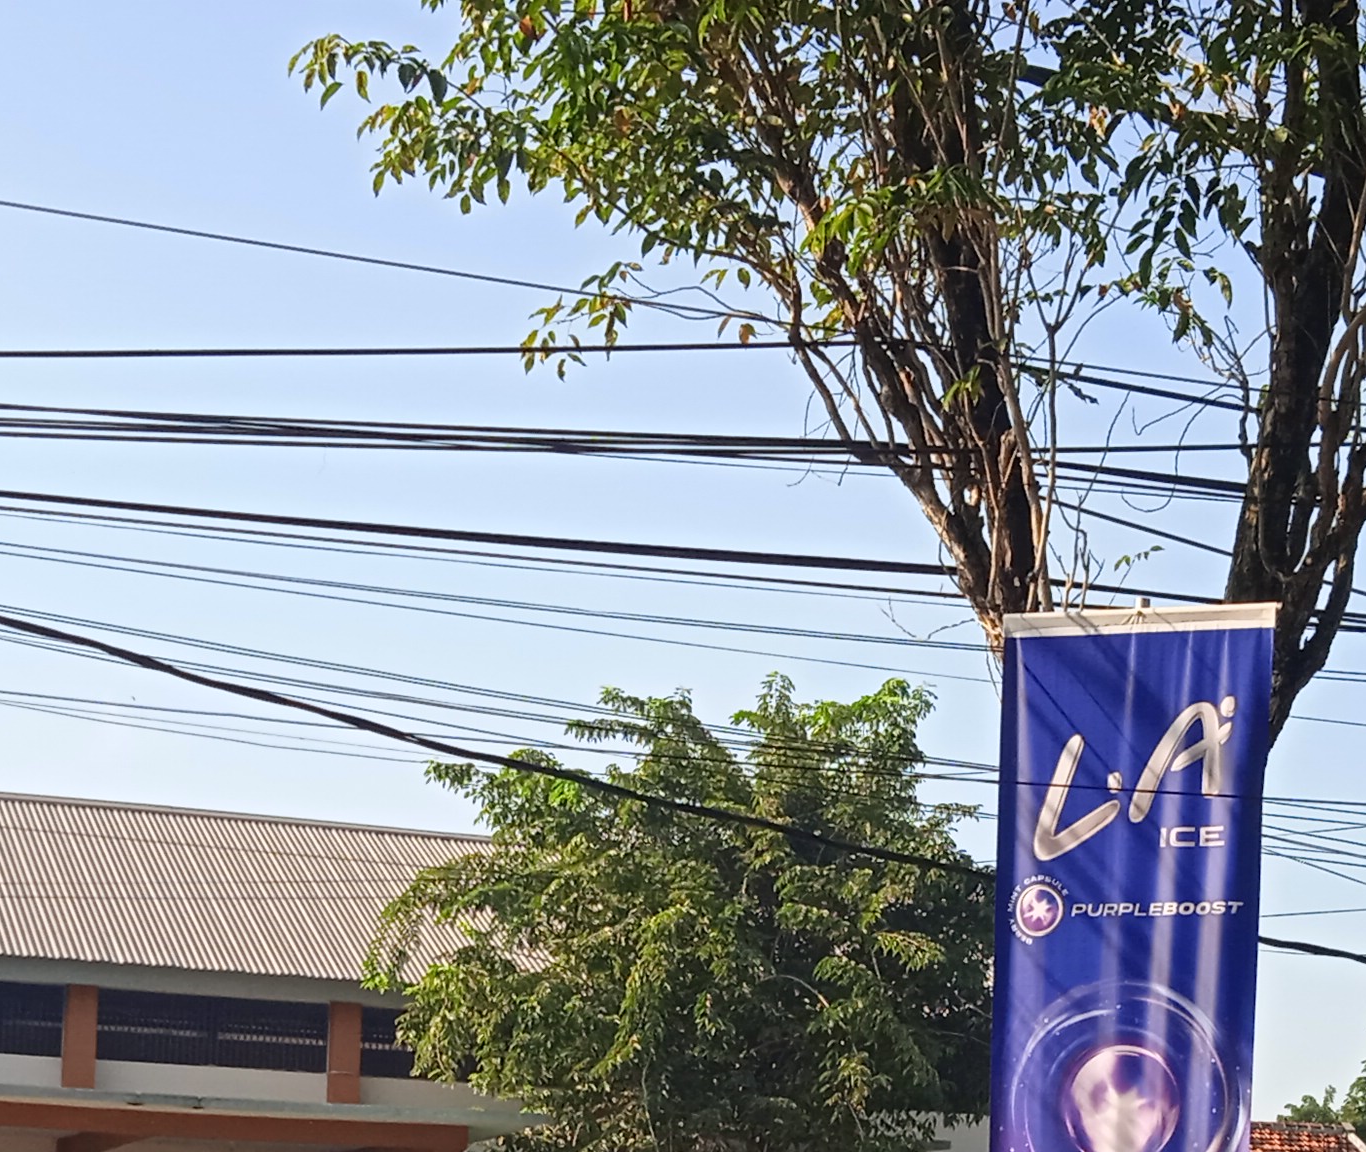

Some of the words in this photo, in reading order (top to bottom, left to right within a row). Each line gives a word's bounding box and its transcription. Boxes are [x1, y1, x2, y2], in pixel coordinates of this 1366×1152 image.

[1159, 825, 1225, 848] ICE
[1024, 875, 1069, 896] CAPSULE
[1070, 901, 1244, 917] PURPLEBOOST
